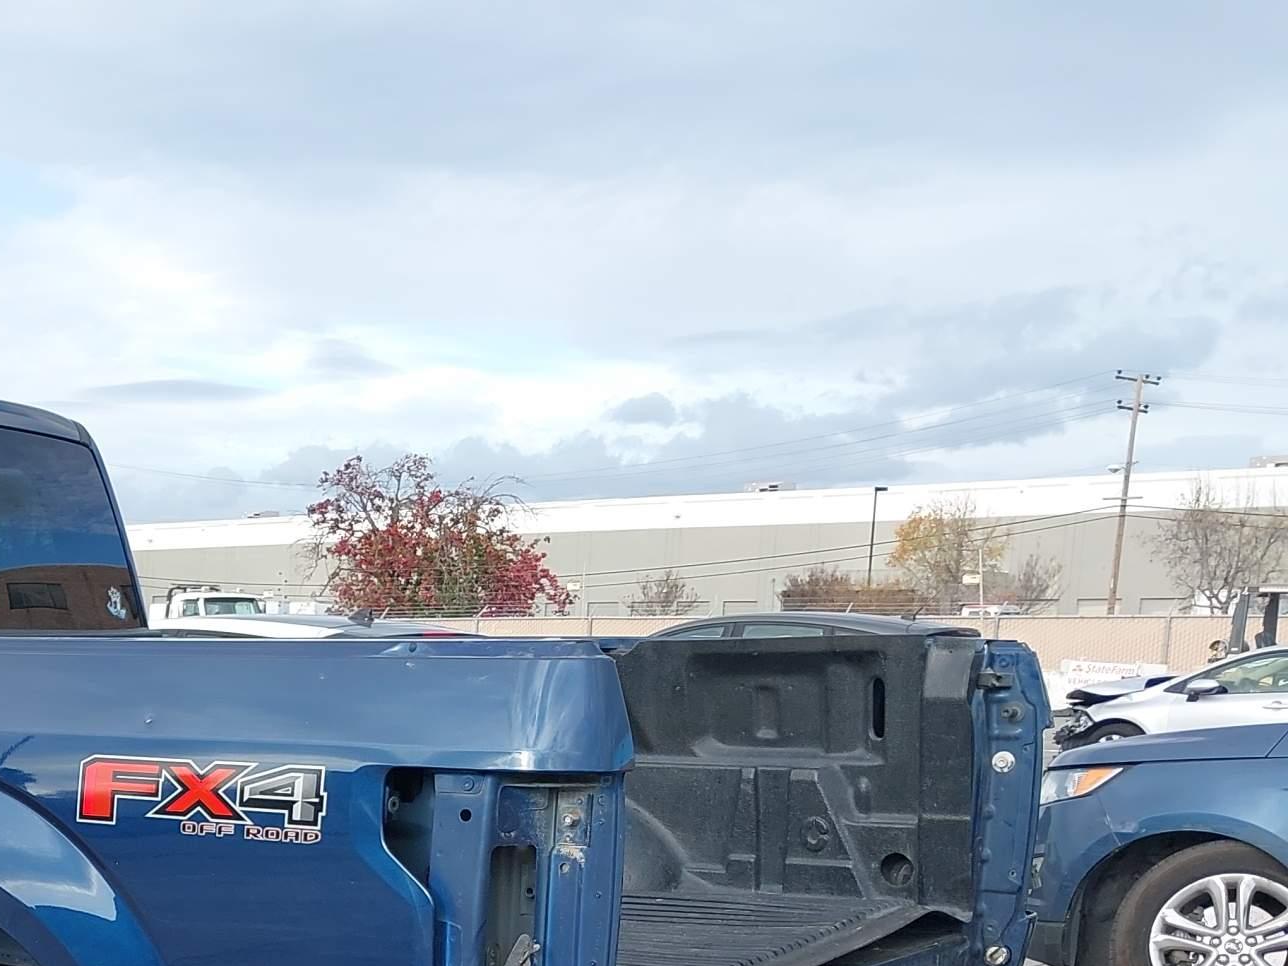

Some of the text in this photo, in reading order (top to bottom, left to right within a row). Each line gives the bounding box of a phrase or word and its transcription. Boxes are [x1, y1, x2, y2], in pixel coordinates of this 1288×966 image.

[77, 754, 327, 830] FX4
[180, 821, 322, 844] OFF ROAD
